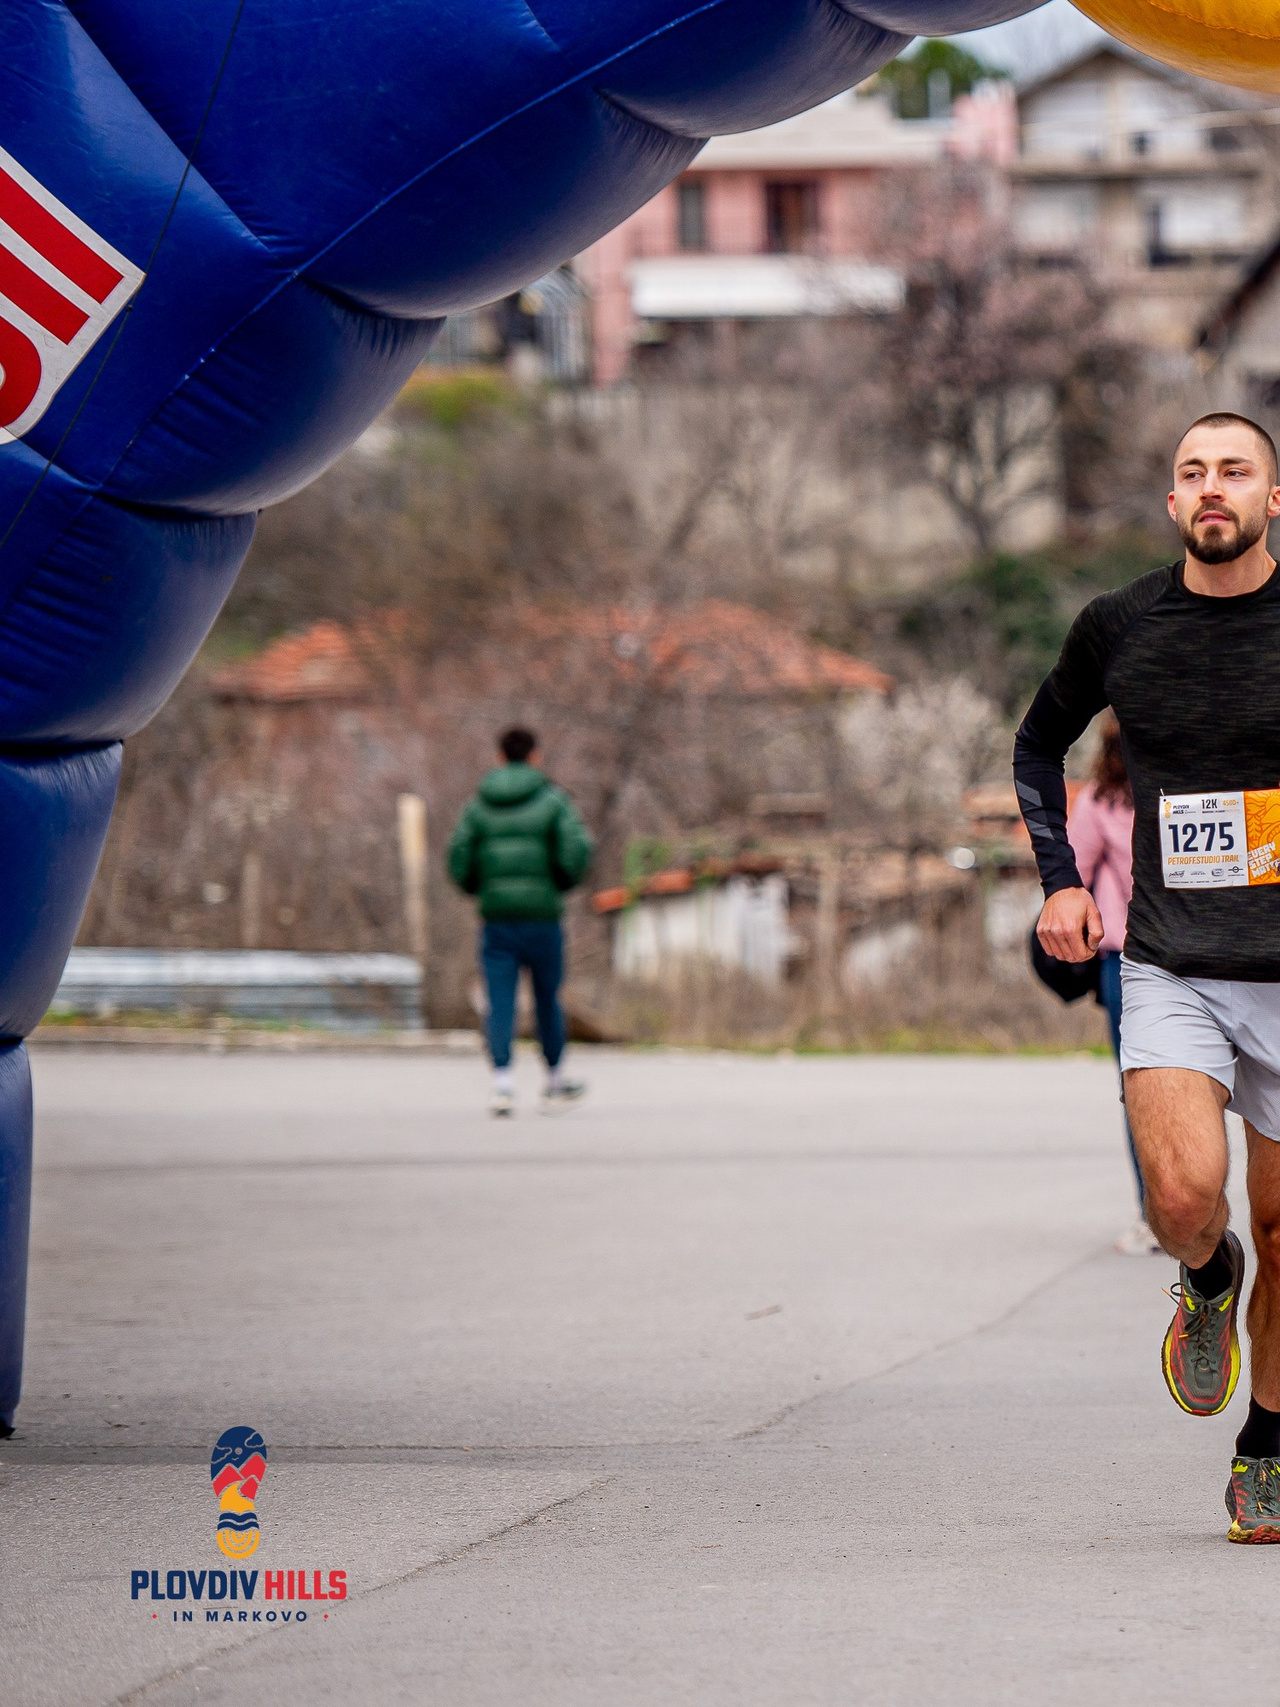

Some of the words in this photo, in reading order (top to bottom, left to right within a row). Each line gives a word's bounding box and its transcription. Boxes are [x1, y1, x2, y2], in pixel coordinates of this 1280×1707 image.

[1201, 798, 1218, 809] 12K
[1168, 821, 1235, 853] 1275
[1221, 854, 1240, 863] TRAIL
[1248, 853, 1273, 870] STEP
